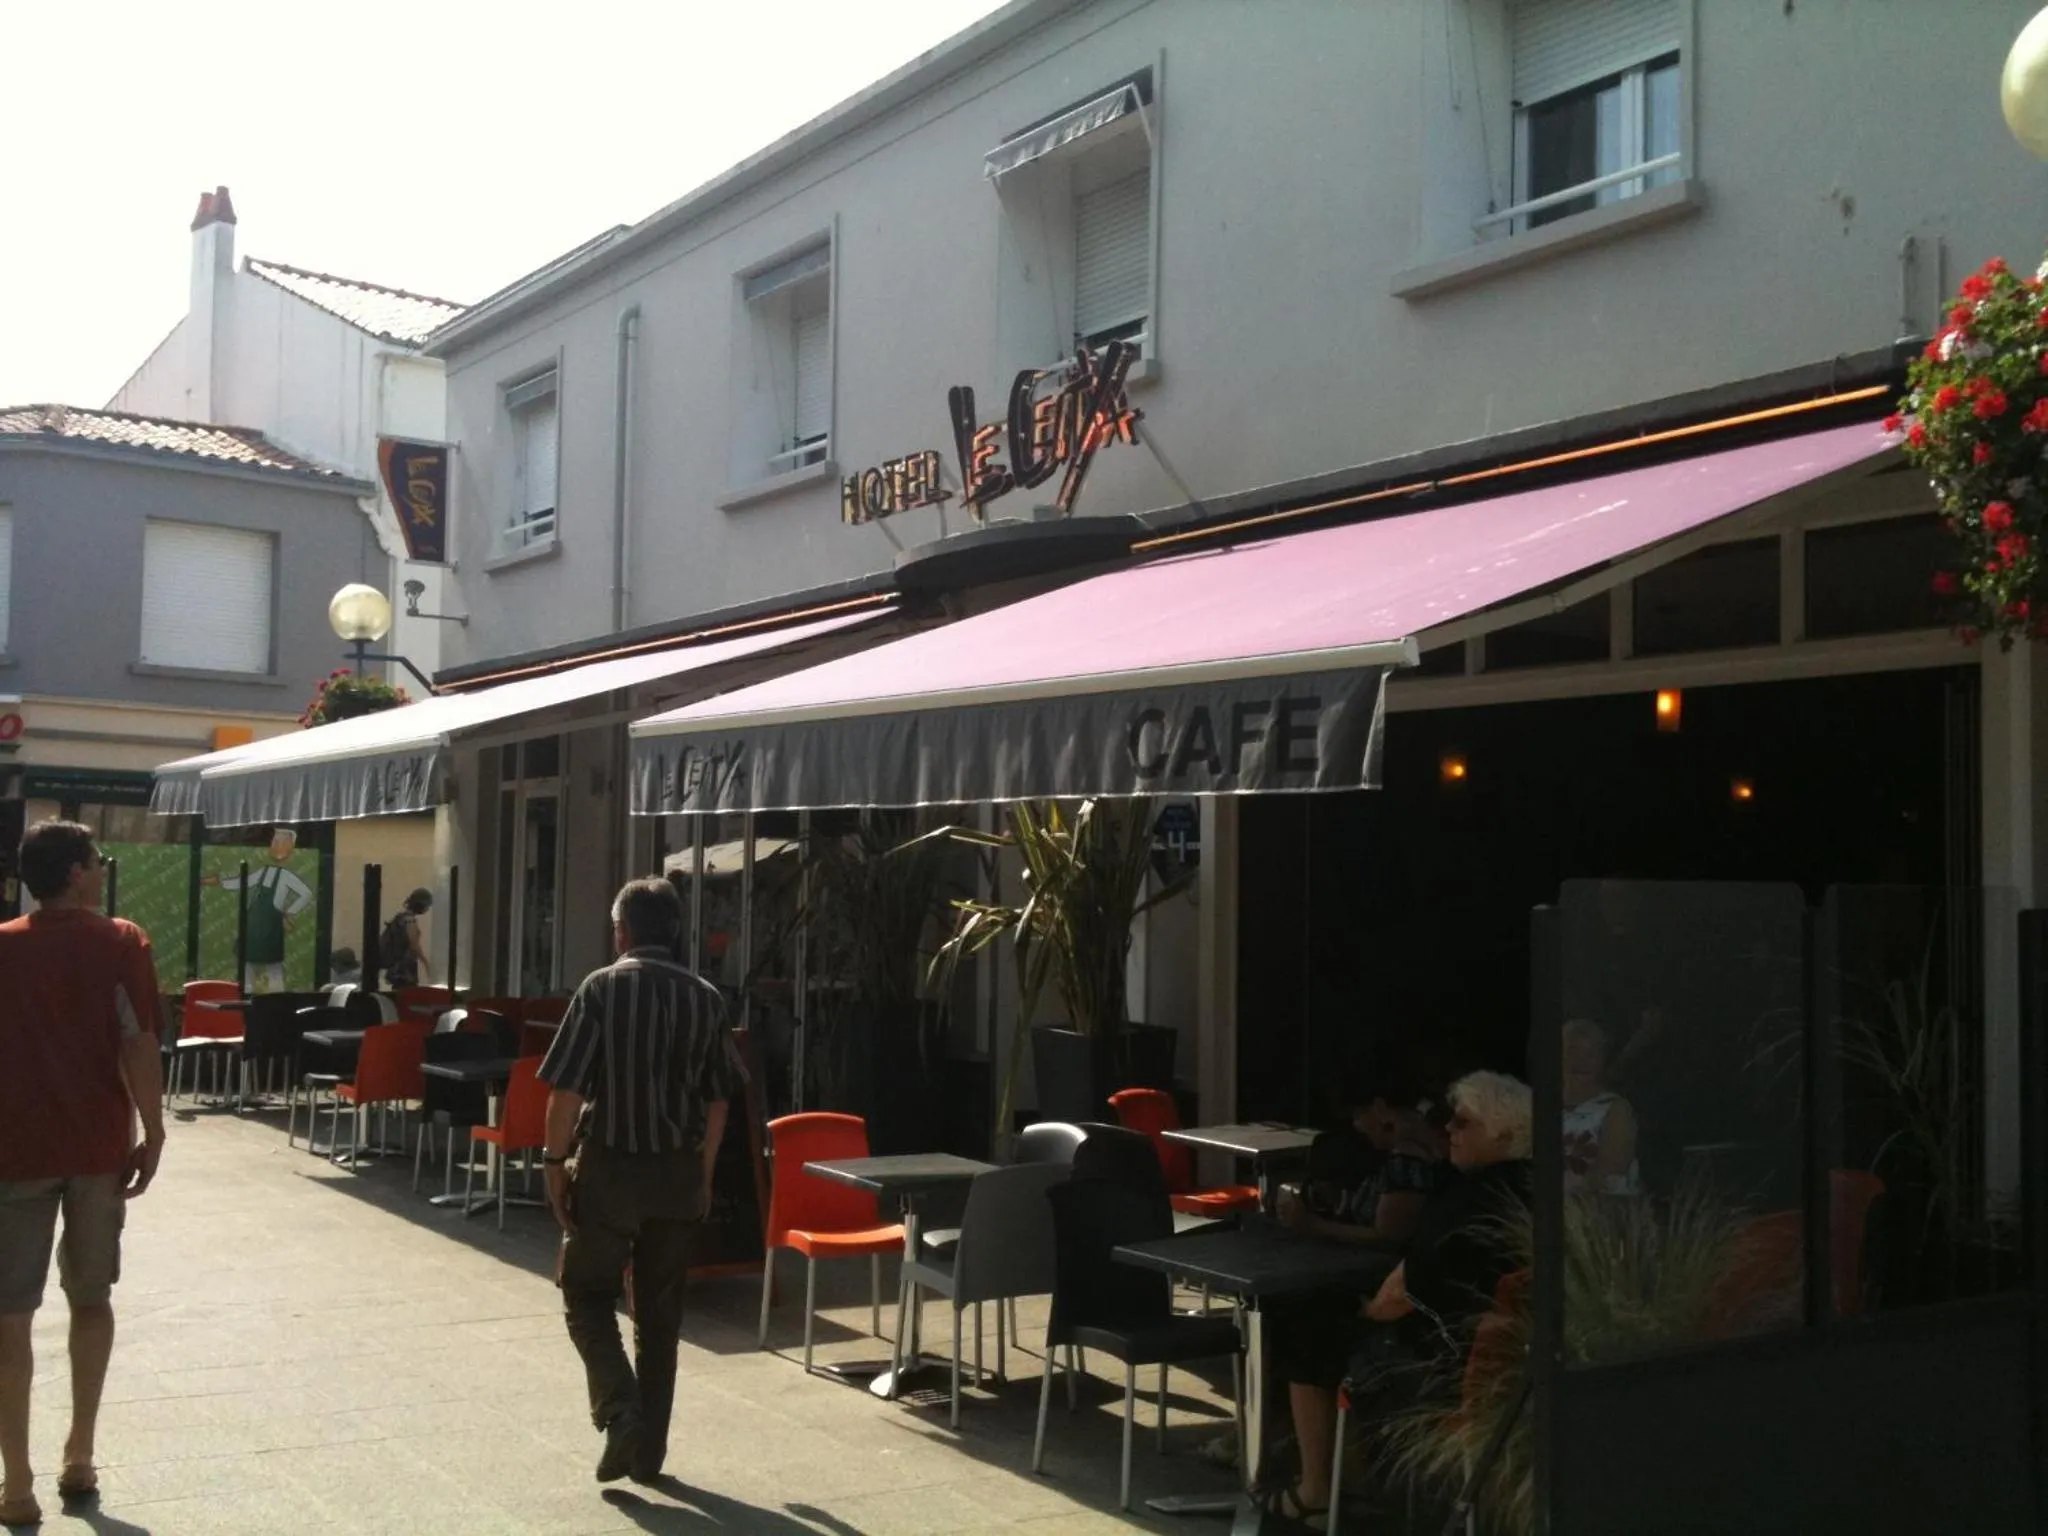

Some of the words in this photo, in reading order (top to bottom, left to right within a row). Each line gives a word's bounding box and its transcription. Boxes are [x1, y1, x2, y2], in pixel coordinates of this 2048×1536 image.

[841, 449, 952, 525] HOTEL
[948, 386, 1015, 504] LE
[1130, 696, 1322, 778] CAFE
